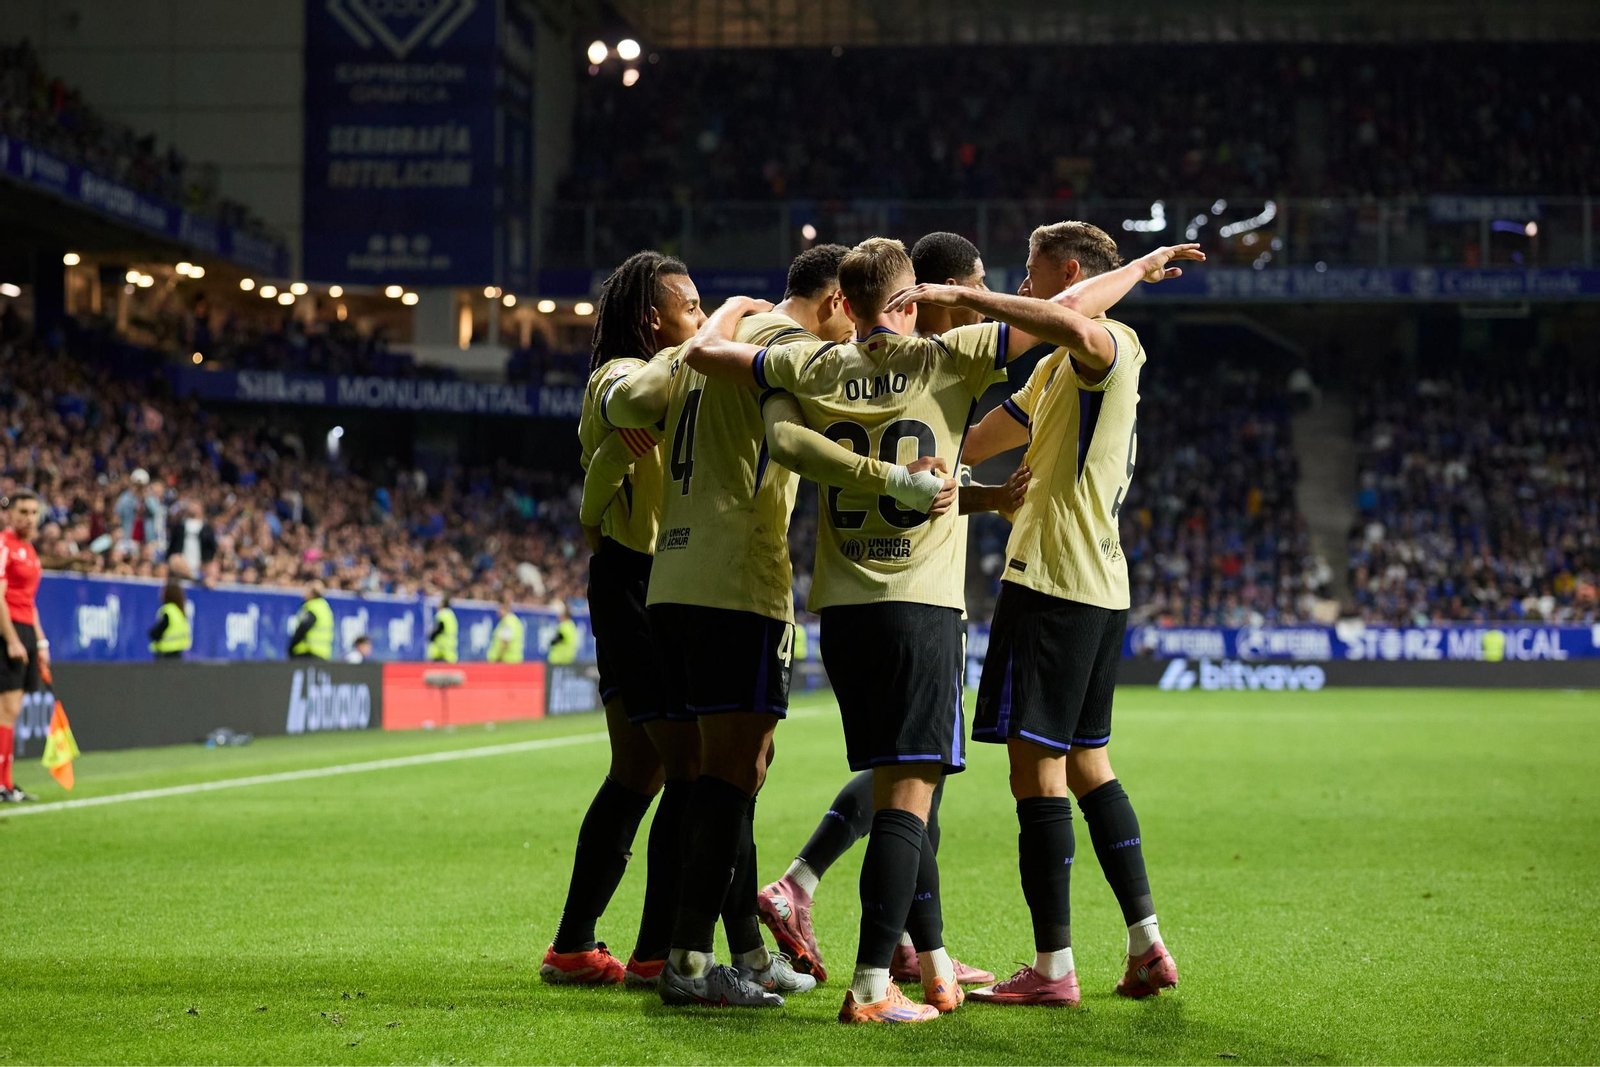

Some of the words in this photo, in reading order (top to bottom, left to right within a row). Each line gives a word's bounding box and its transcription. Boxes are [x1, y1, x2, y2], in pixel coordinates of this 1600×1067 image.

[338, 377, 533, 415] MONUMENTAL
[845, 373, 908, 401] OLMO
[671, 389, 702, 496] 4
[868, 538, 911, 548] UNHCR
[868, 547, 911, 557] ACNUR
[777, 623, 793, 668] 4
[1448, 629, 1568, 661] MEICAL
[1200, 657, 1326, 691] bitvavo
